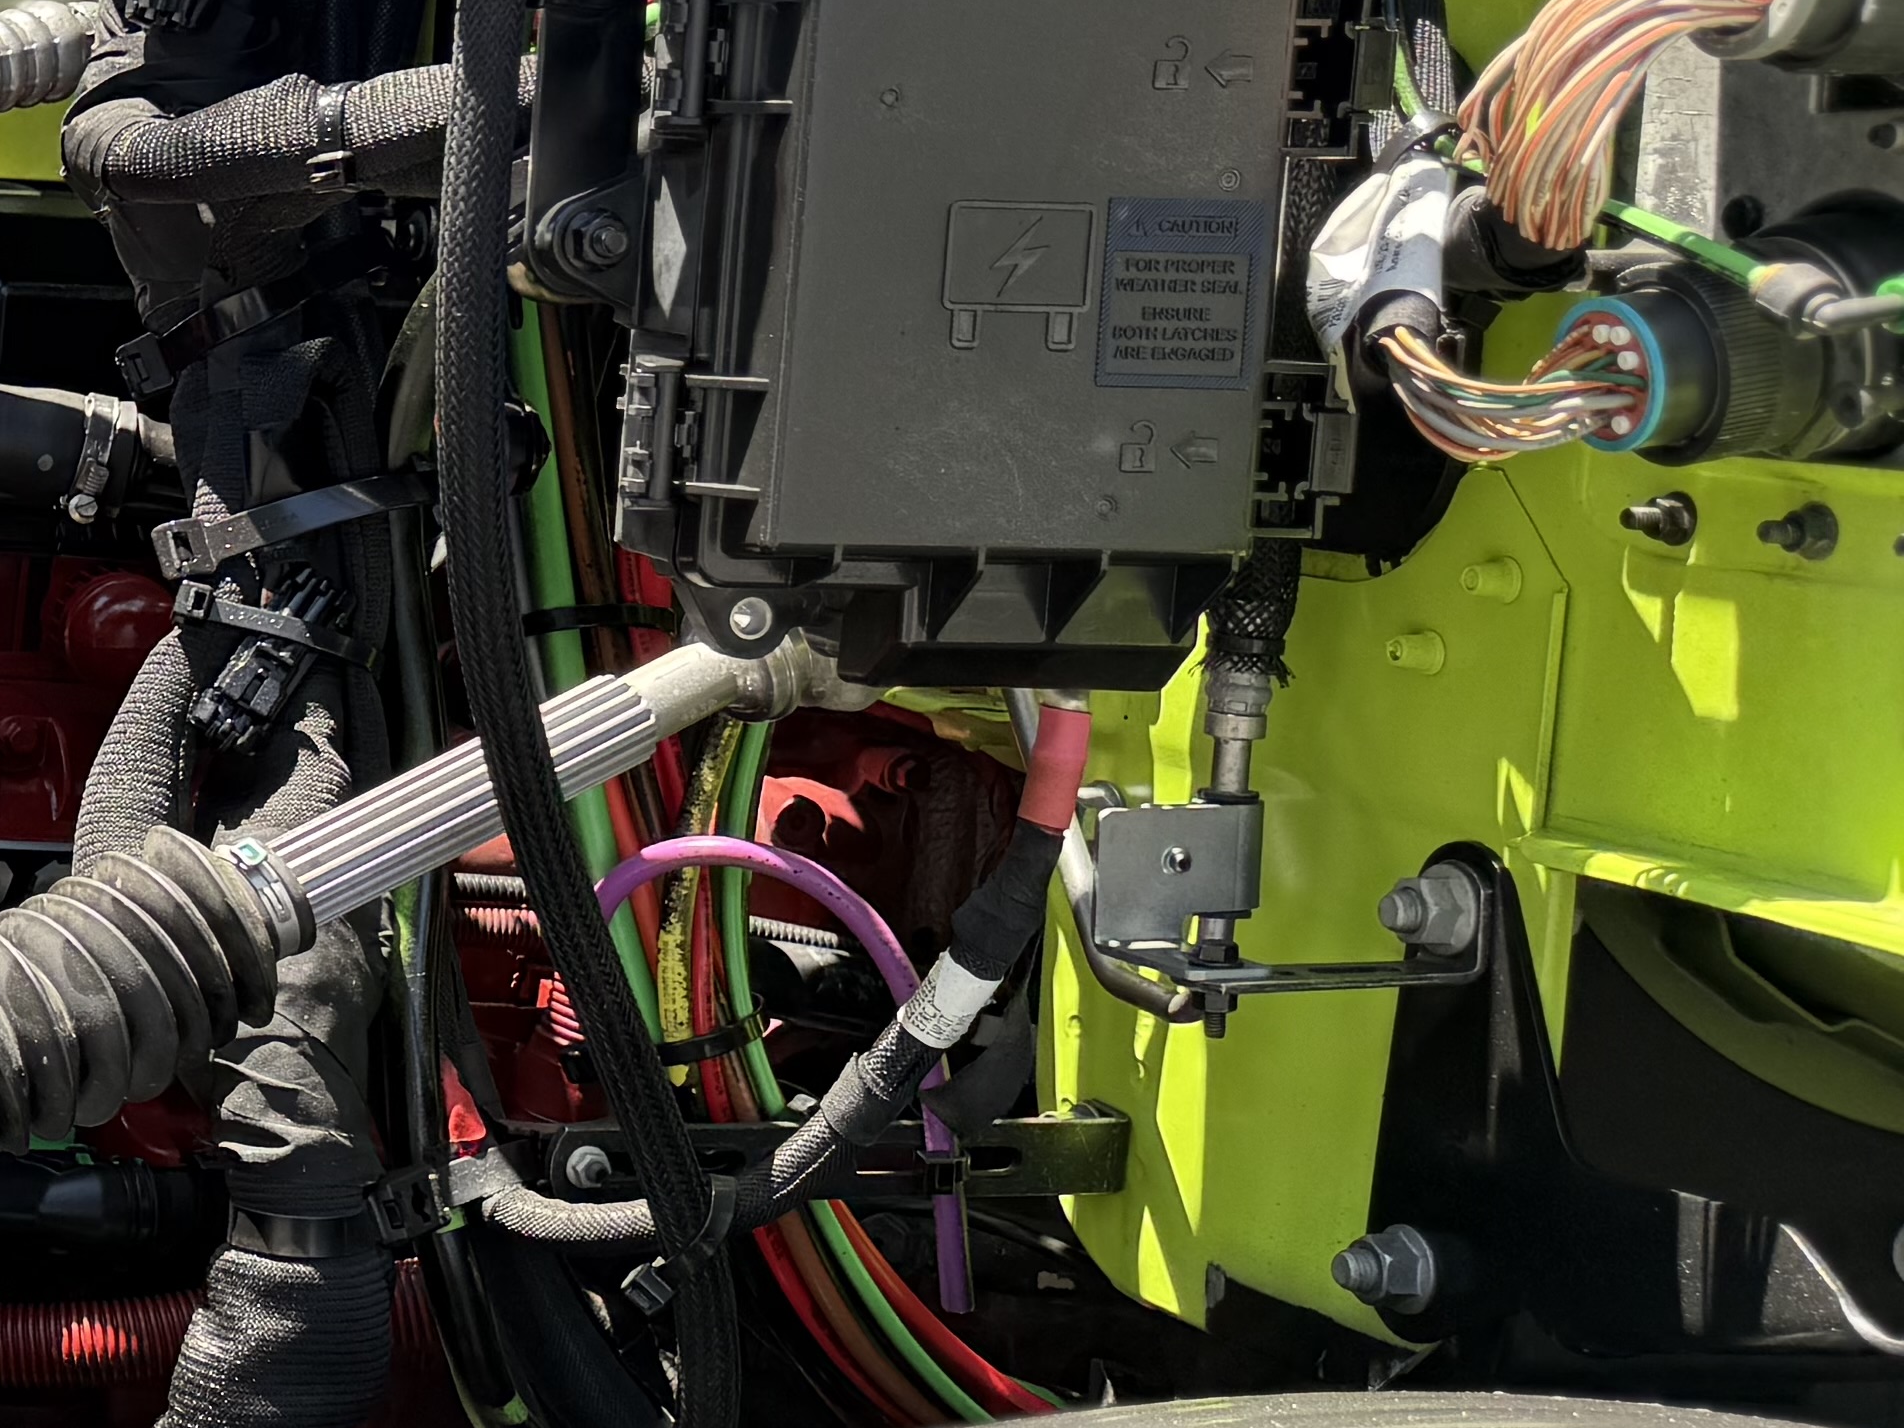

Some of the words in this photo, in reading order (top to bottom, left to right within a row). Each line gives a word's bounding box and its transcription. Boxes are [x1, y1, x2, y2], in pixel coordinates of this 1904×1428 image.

[1158, 219, 1234, 235] CAUTION
[1125, 258, 1160, 272] FOR
[1164, 259, 1235, 274] PROPER
[1115, 278, 1196, 292] WEATHER
[1142, 306, 1211, 321] ENSURE
[1112, 325, 1158, 341] BOTH
[1162, 327, 1238, 342] LATCHES
[1113, 346, 1147, 360] ARE
[1151, 346, 1235, 362] ENGAGED
